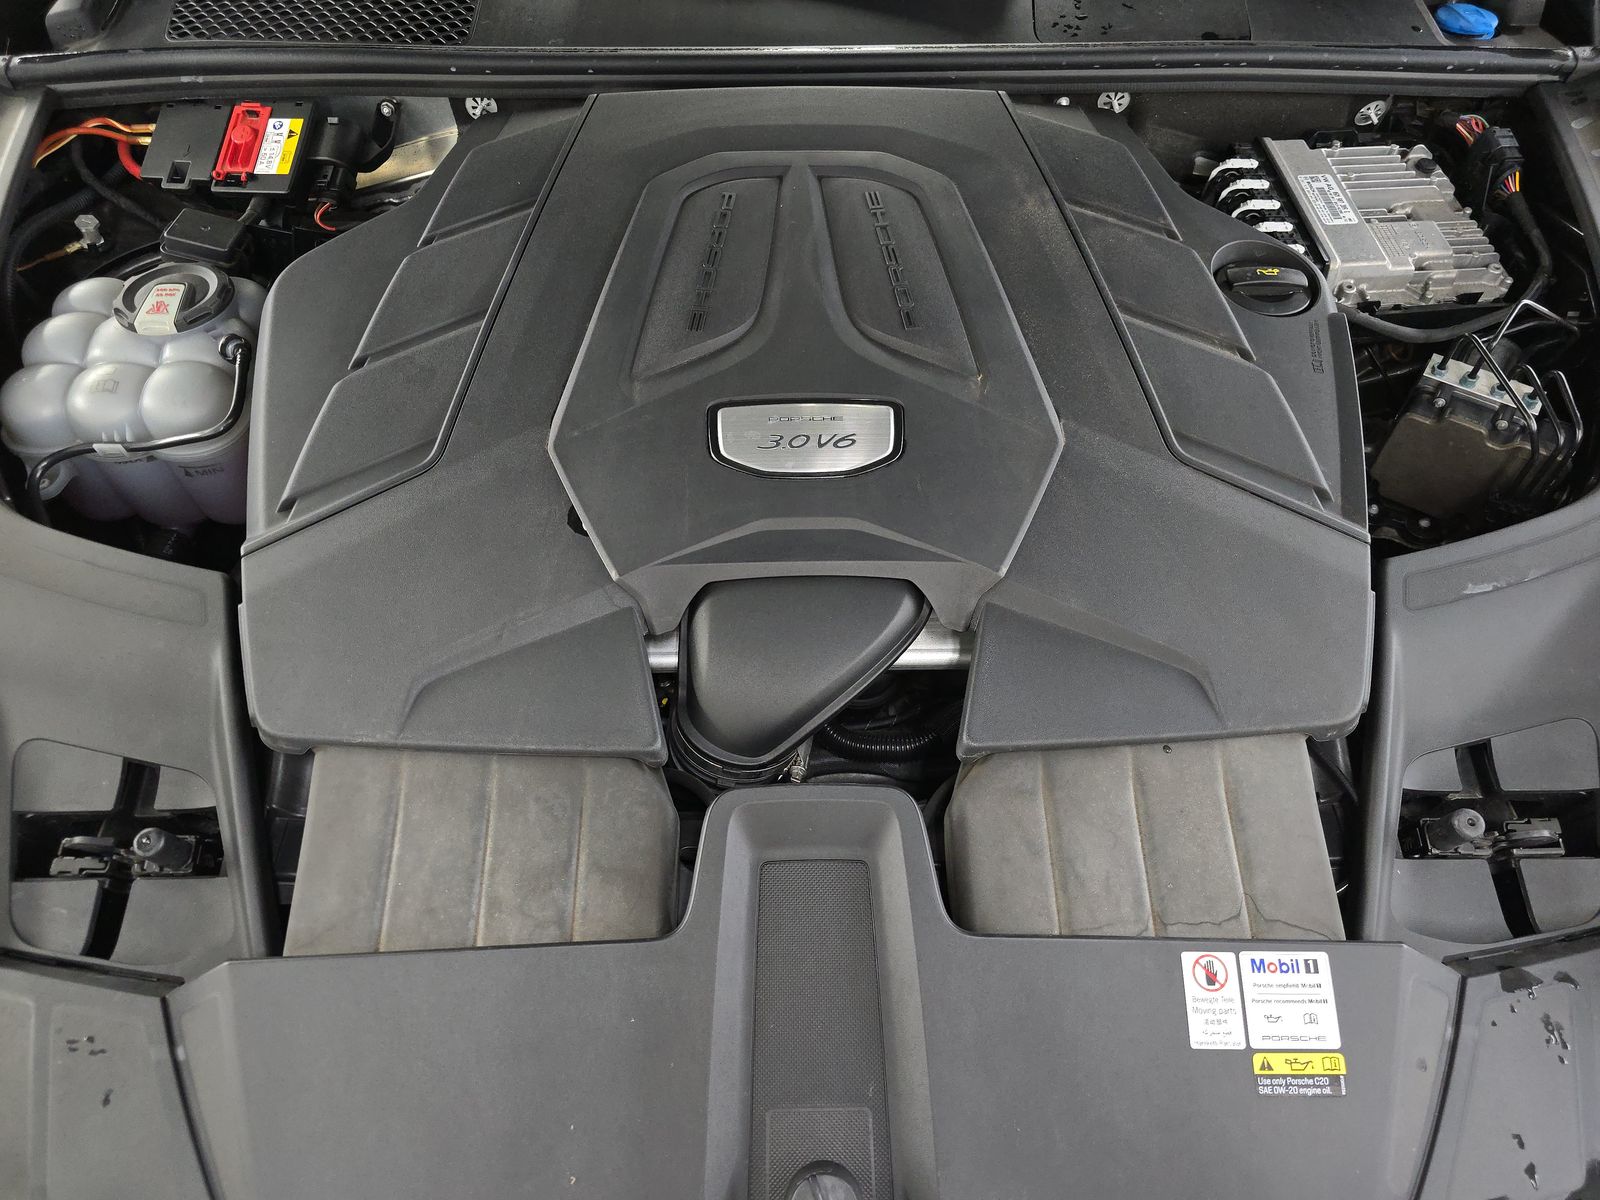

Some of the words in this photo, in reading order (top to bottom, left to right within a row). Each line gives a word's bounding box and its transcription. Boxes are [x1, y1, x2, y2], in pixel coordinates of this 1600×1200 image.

[686, 191, 737, 332] PORSCHE
[864, 191, 920, 330] PORSCHE
[768, 415, 844, 423] PORSCHE
[757, 433, 811, 450] 3.0
[817, 432, 857, 449] V6
[1250, 958, 1300, 974] Mobil
[1303, 958, 1319, 974] 1
[1191, 1006, 1217, 1016] Moving
[1218, 1007, 1237, 1016] parts
[1257, 1077, 1271, 1085] Use
[1271, 1077, 1286, 1087] only
[1286, 1077, 1314, 1085] Porsche
[1314, 1077, 1329, 1085] C20
[1258, 1086, 1273, 1095] SAE
[1273, 1086, 1299, 1095] 0W-20
[1299, 1087, 1322, 1096] engine
